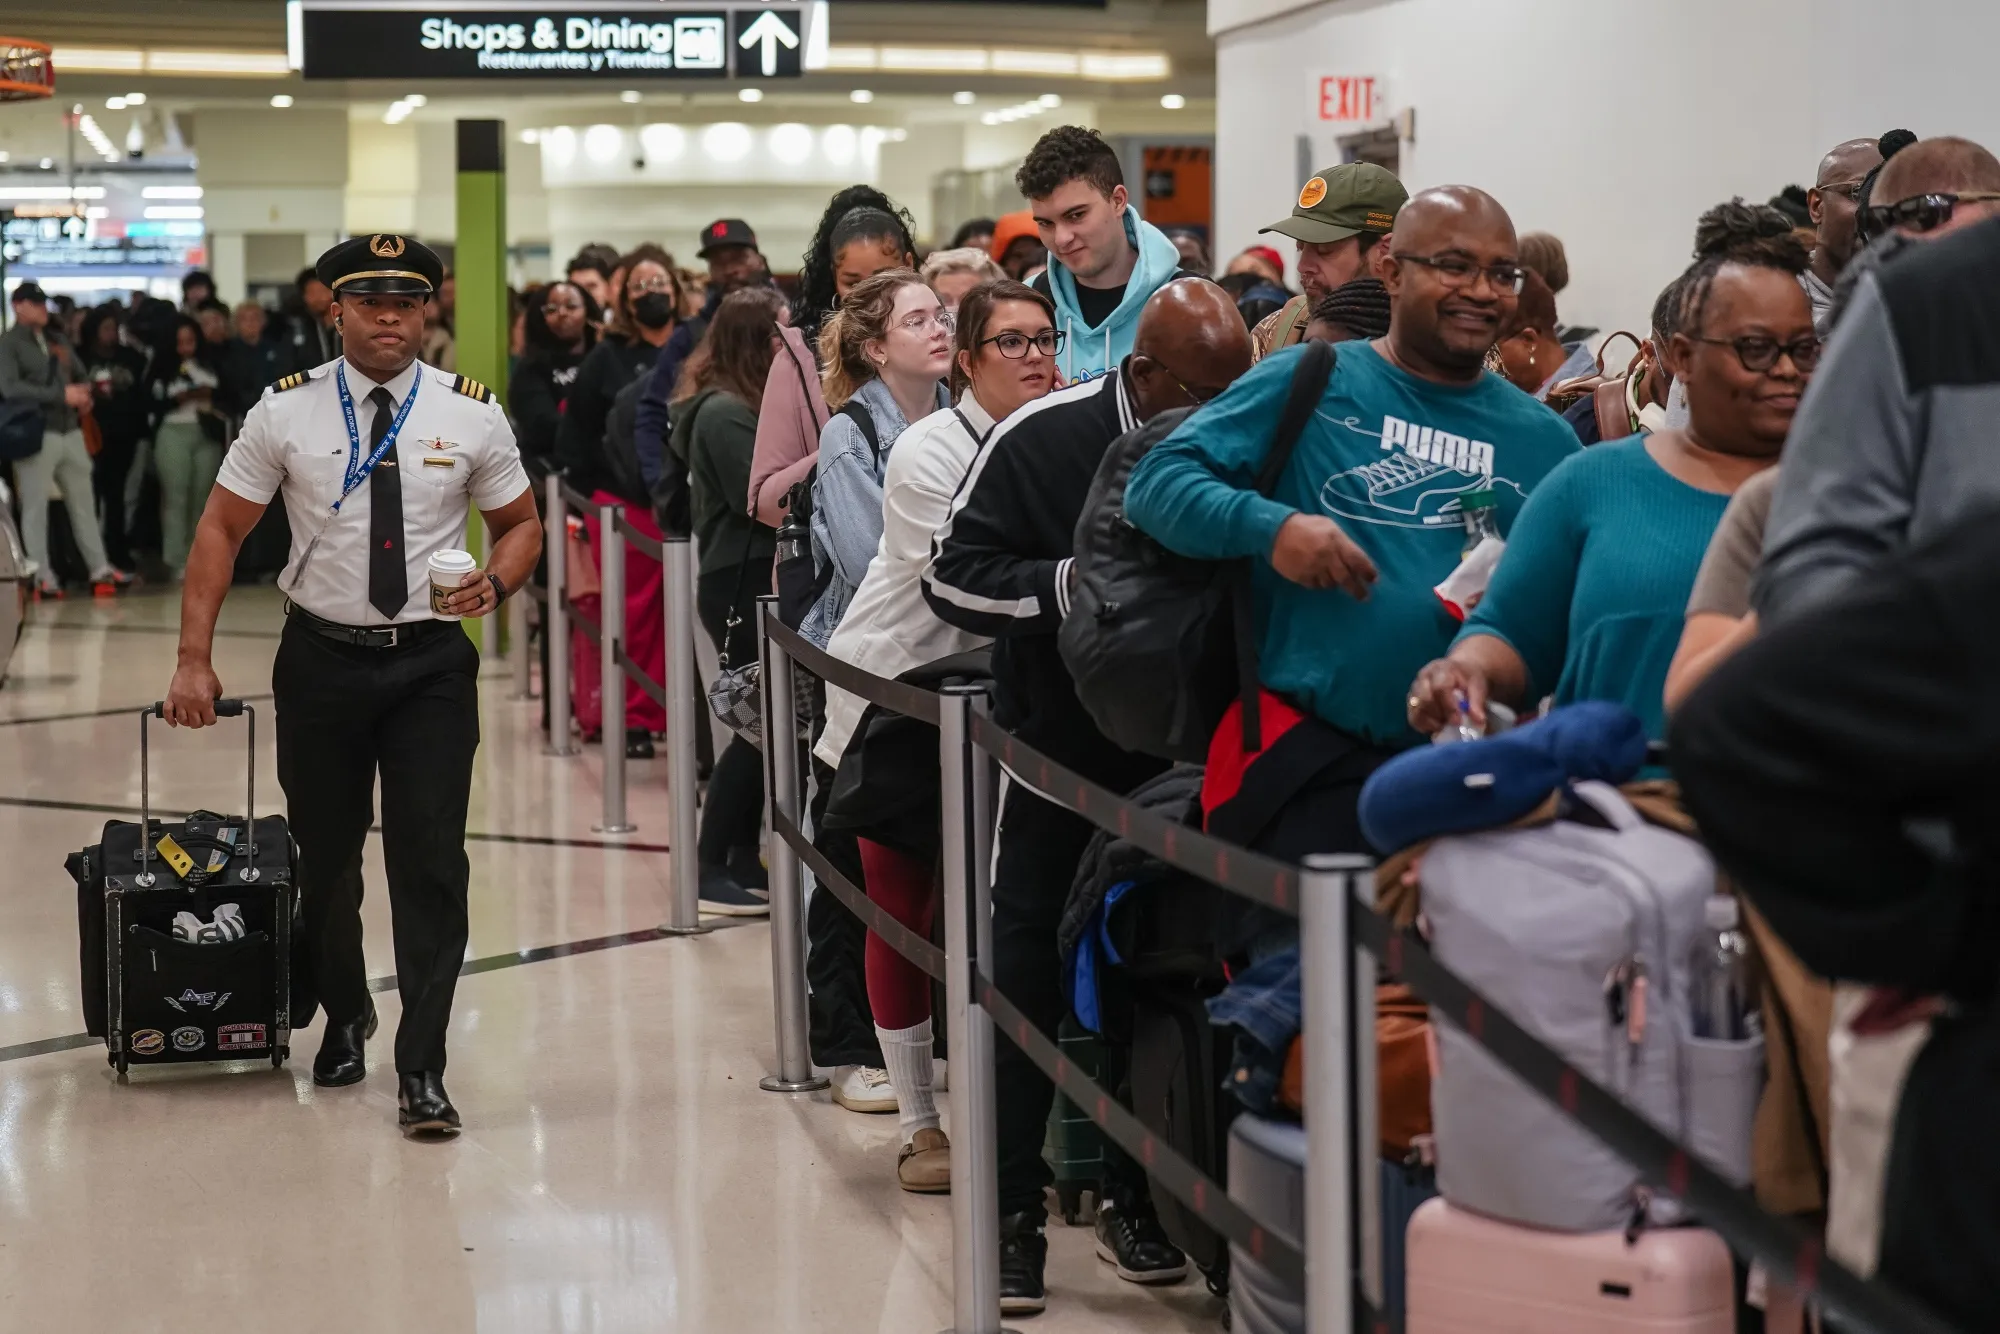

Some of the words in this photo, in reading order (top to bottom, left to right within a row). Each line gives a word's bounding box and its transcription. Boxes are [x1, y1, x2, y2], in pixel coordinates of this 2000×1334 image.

[420, 17, 525, 53] Shops
[531, 17, 560, 49] &
[565, 17, 673, 54] Dining
[477, 50, 590, 69] Restaurantes
[589, 53, 604, 71] y
[604, 50, 673, 69] Tiendas
[1319, 76, 1375, 121] EXIT
[348, 415, 357, 434] FORCE
[367, 456, 377, 468] AIR
[374, 438, 390, 459] FORCE
[394, 418, 402, 430] AIR
[398, 401, 411, 421] FORCE
[1380, 414, 1495, 477] PUMA
[347, 459, 357, 480] FORCE
[217, 1023, 267, 1033] AFGHANISTAN
[241, 1041, 267, 1049] VETERAN
